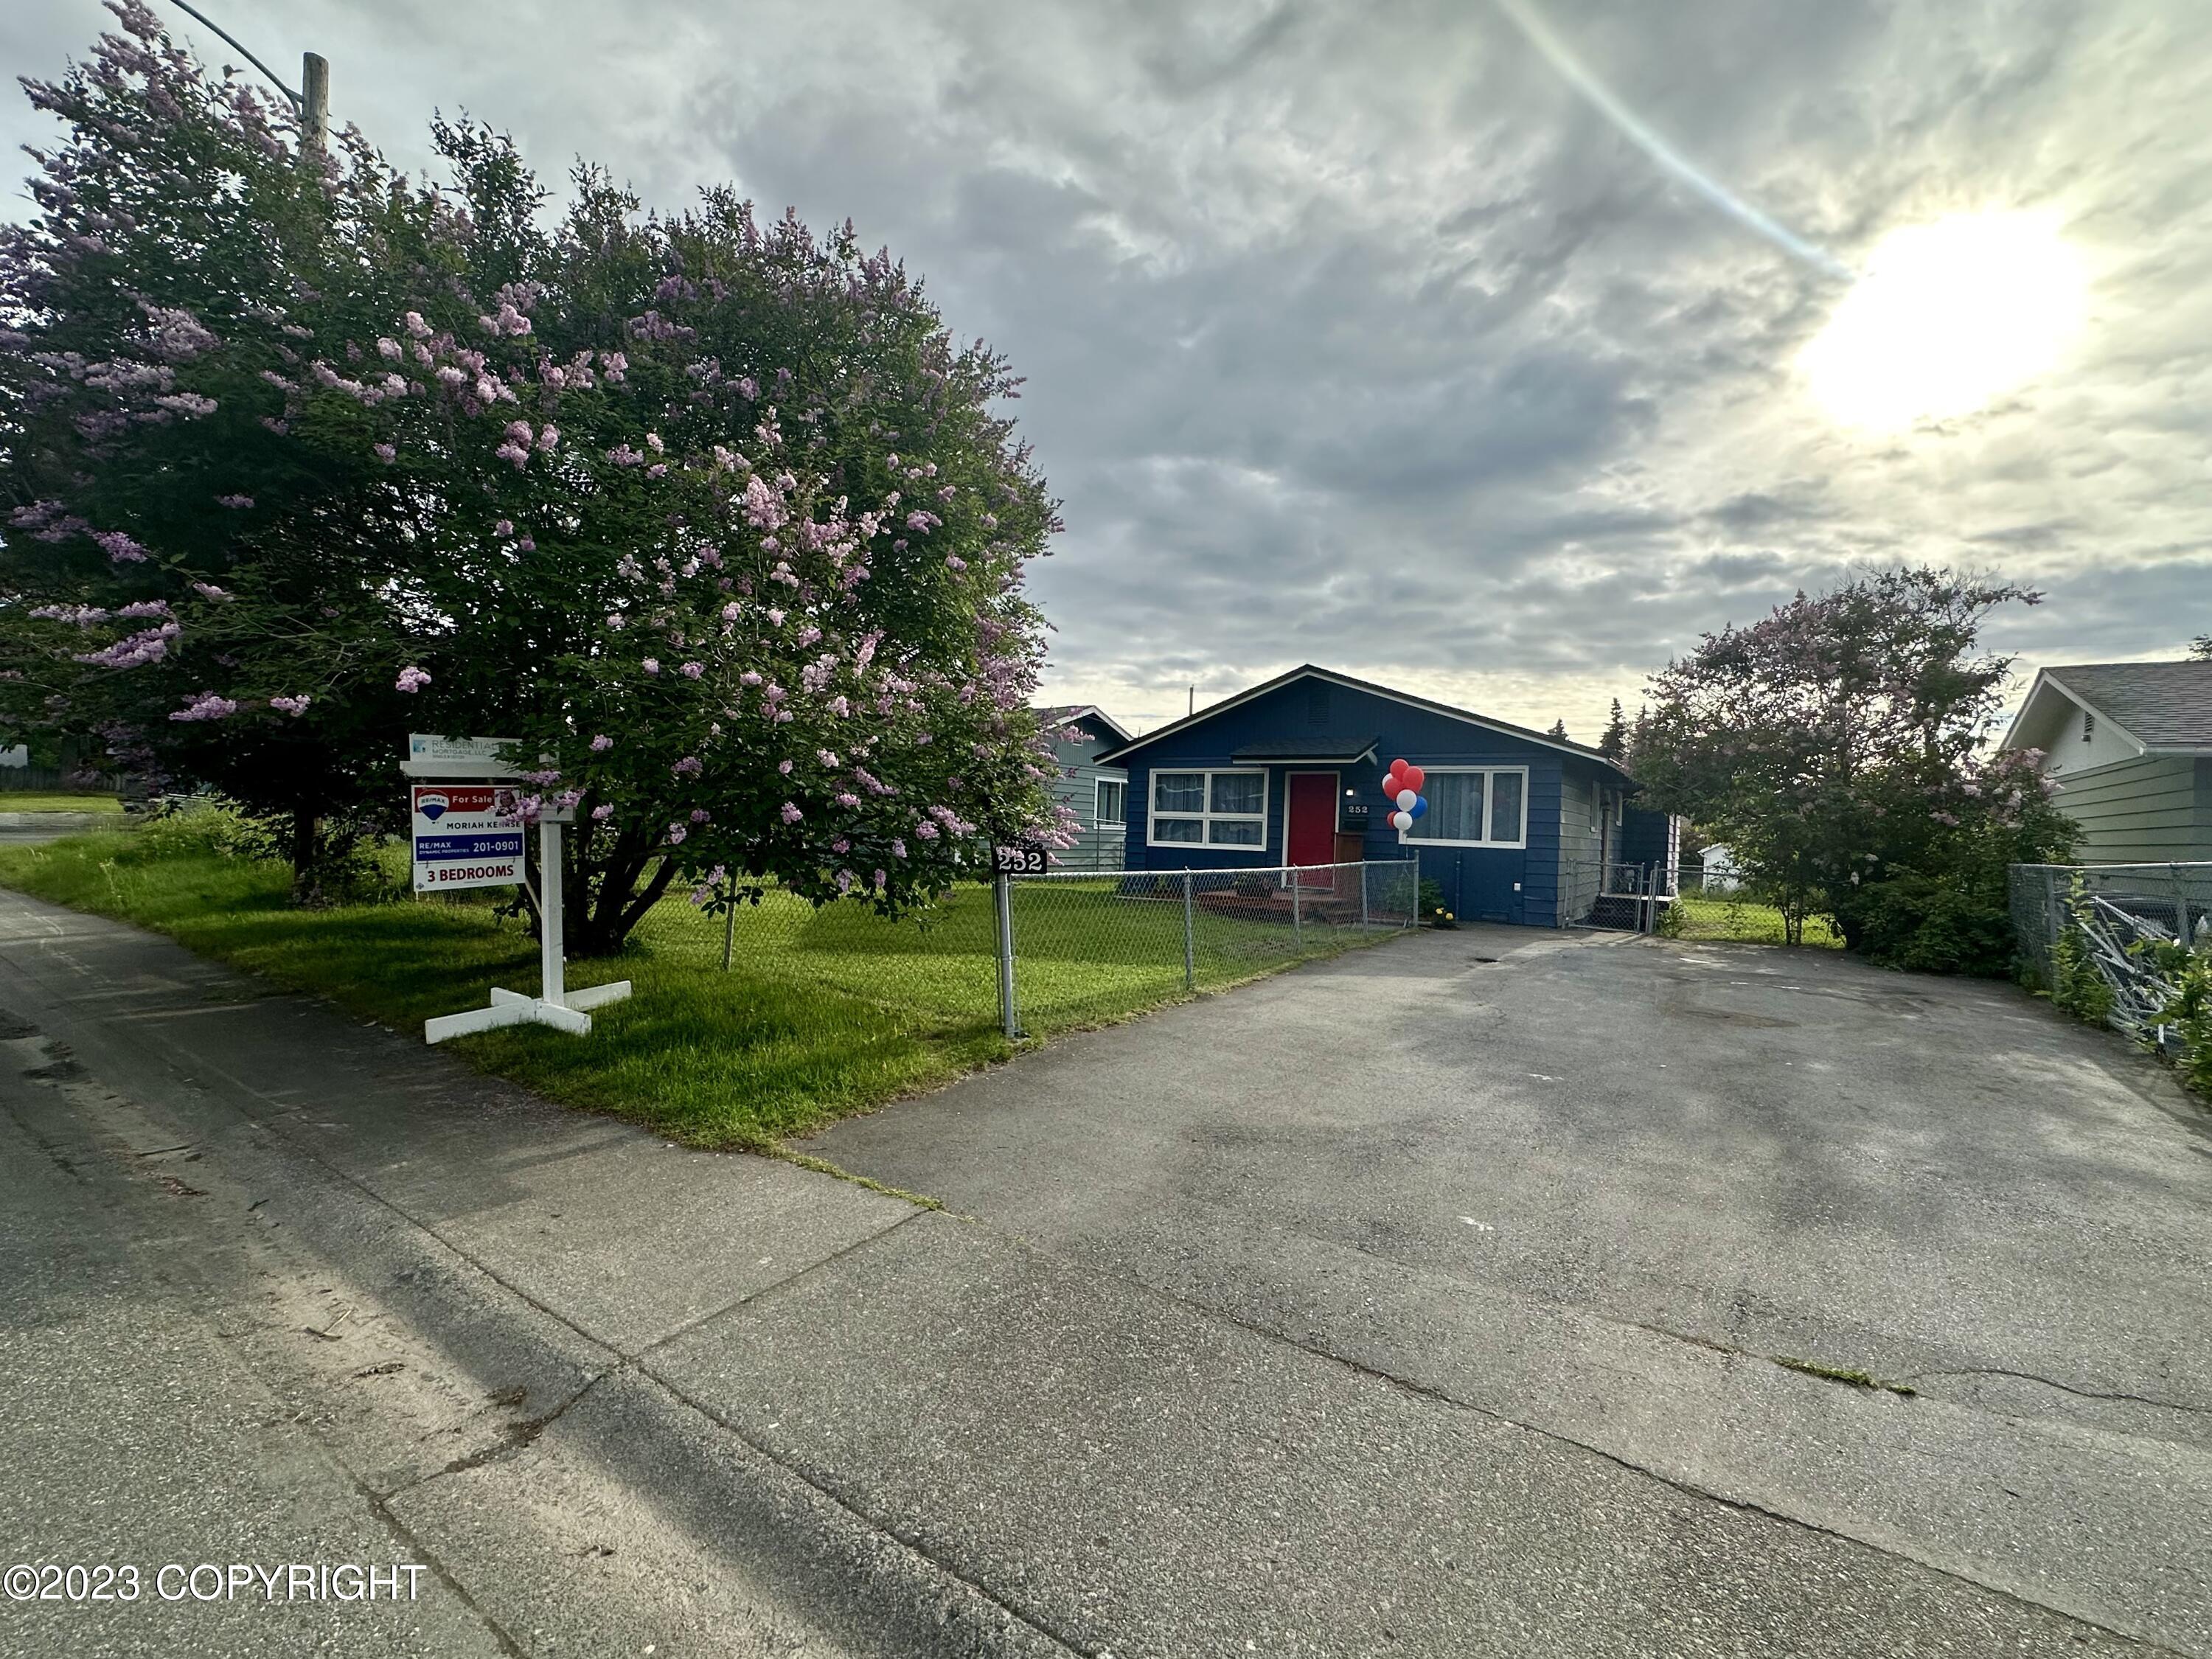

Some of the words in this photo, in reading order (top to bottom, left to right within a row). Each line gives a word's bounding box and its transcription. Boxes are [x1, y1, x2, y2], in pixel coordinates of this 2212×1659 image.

[432, 740, 498, 750] RESIDENTIAL
[452, 796, 469, 804] For
[472, 795, 493, 804] Sale
[1348, 805, 1368, 813] 252
[447, 821, 484, 830] MORIAH
[473, 841, 518, 852] 201-0901
[998, 852, 1043, 871] 252
[428, 870, 436, 883] 3
[439, 864, 514, 882] BEDROOMS
